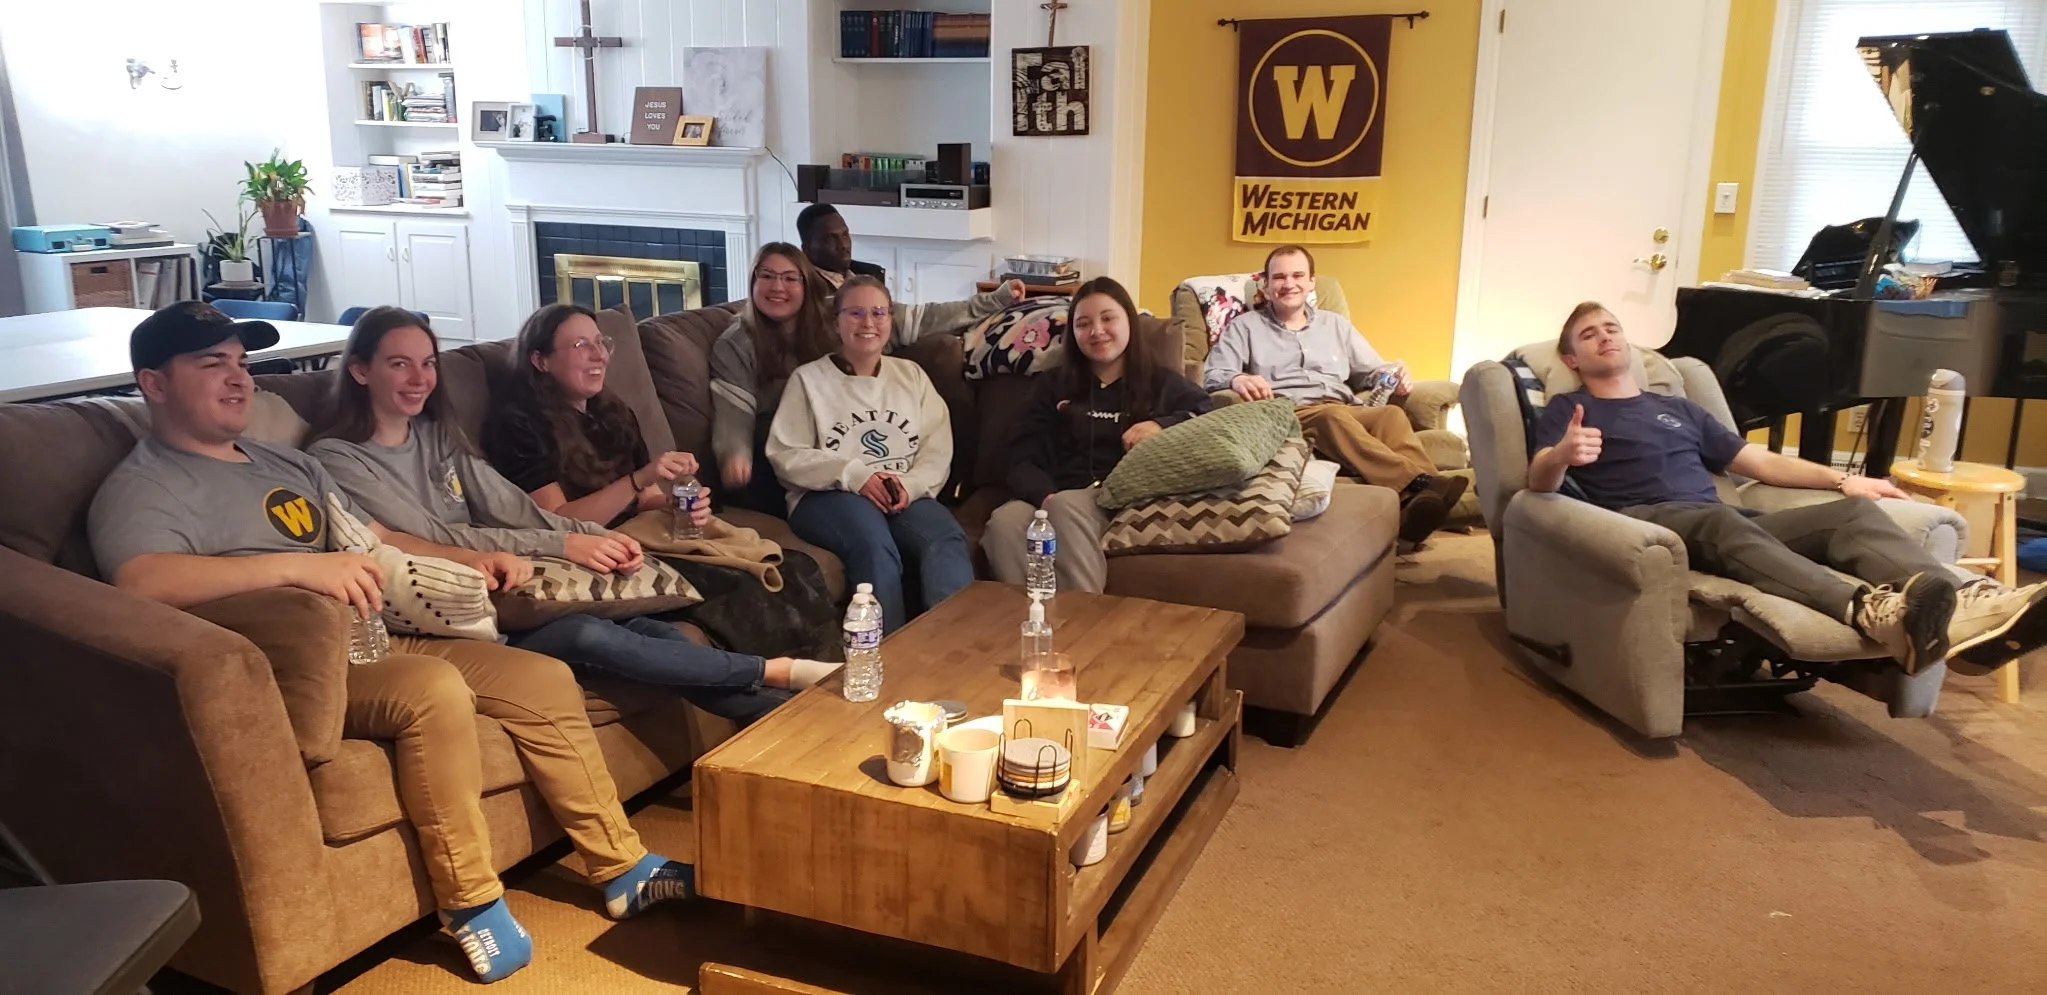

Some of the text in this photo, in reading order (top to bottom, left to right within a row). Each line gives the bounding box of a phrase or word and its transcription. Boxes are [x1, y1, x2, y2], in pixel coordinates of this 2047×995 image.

[644, 101, 667, 109] JESUS
[1273, 64, 1356, 140] W
[1241, 184, 1359, 210] WESTERN
[1241, 211, 1371, 236] MICHIGAN
[825, 409, 920, 452] SEATTLE
[270, 496, 315, 538] W
[477, 928, 501, 958] DETROIT
